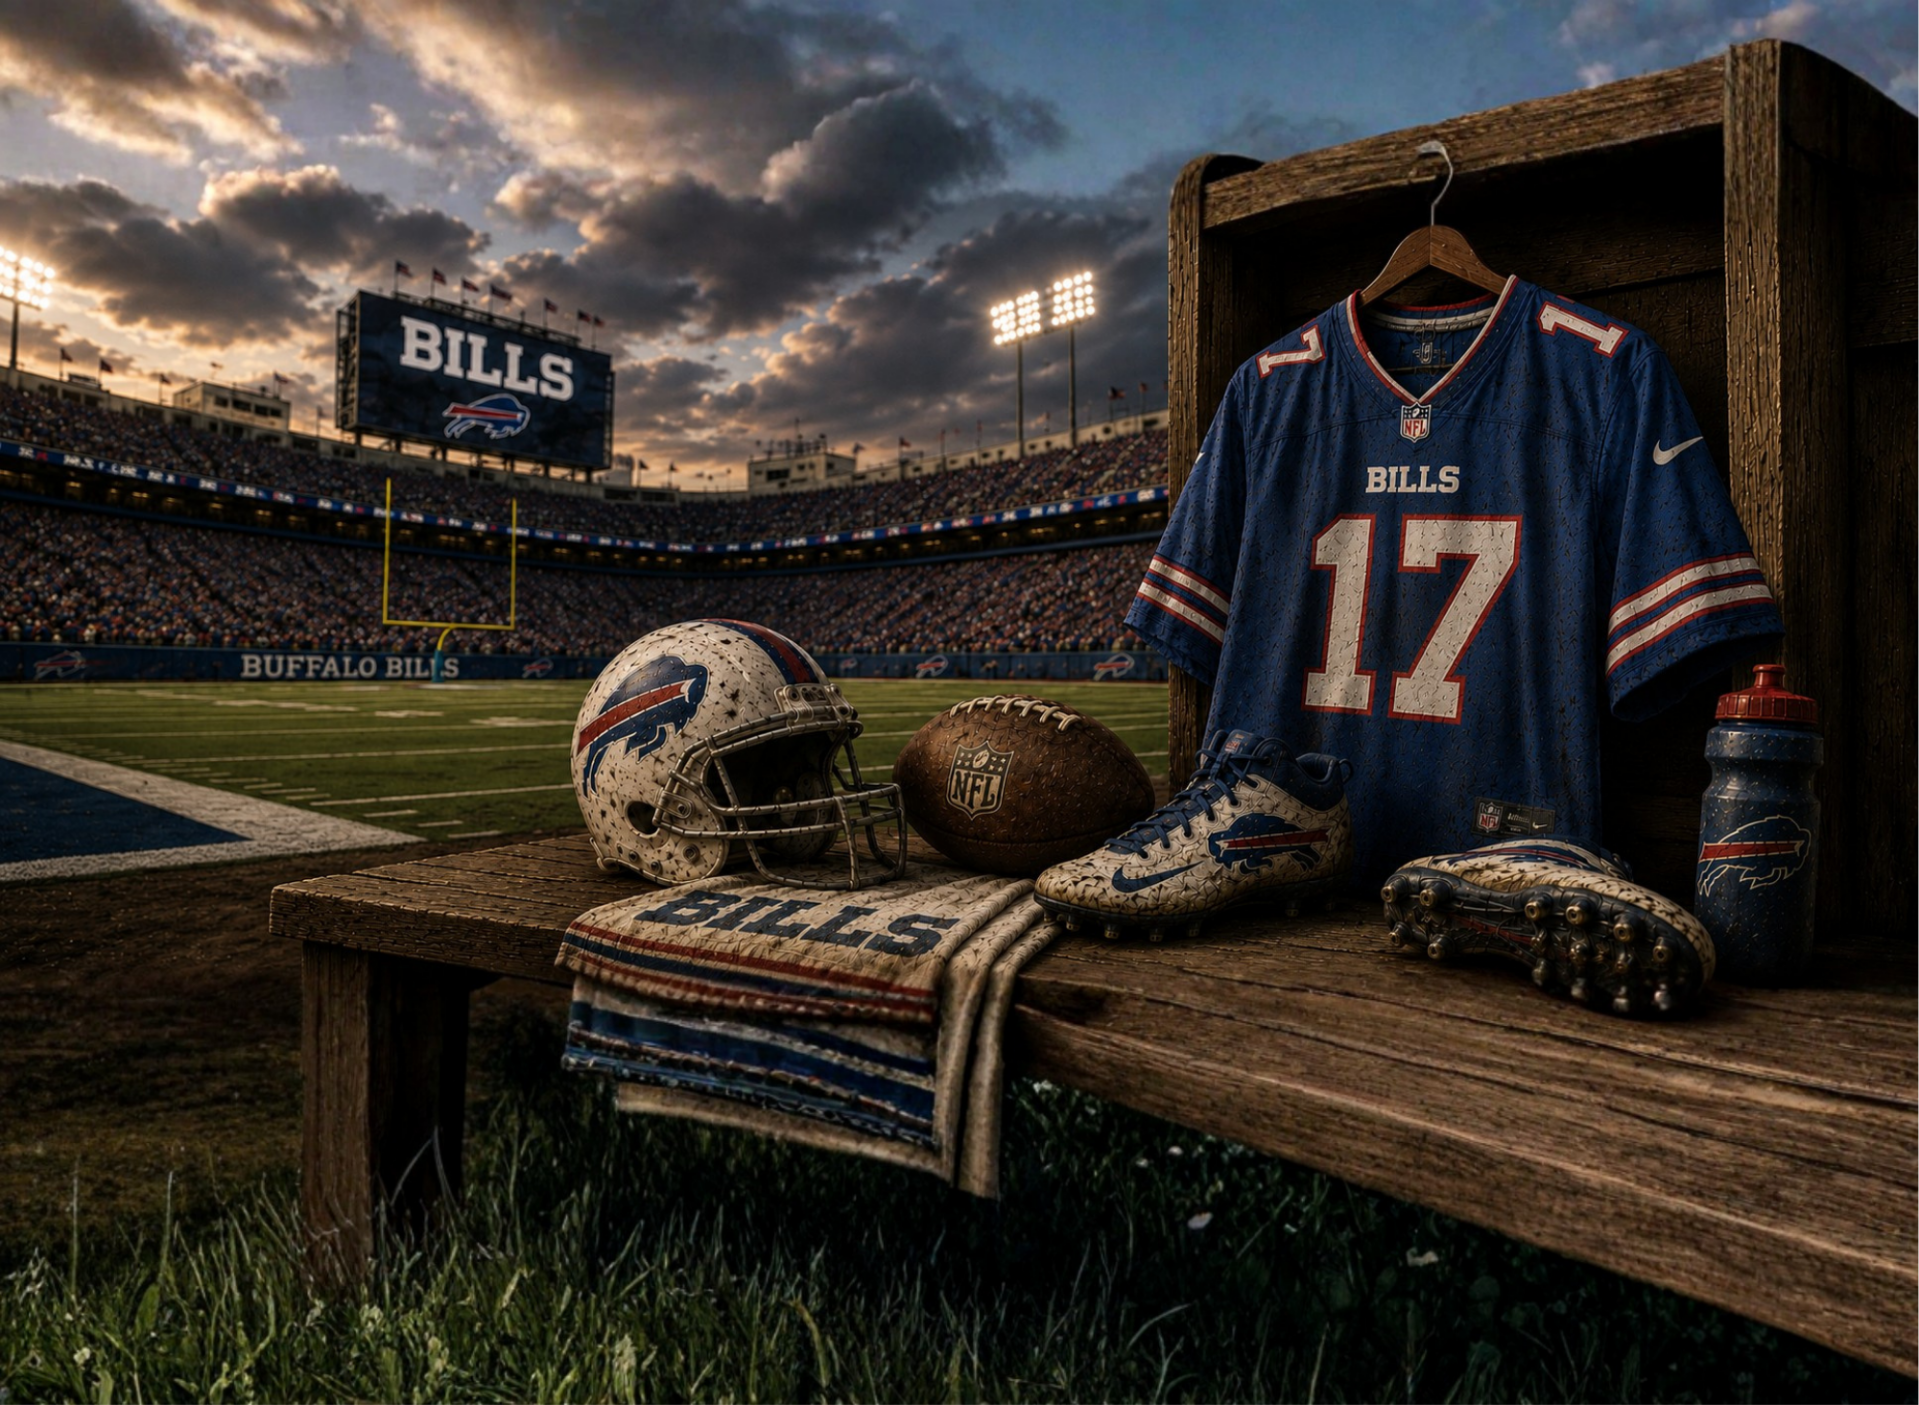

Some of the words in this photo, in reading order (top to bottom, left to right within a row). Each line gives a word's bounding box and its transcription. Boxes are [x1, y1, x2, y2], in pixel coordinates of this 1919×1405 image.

[400, 315, 574, 401] BILLS
[1404, 419, 1427, 437] NFL
[1365, 465, 1460, 494] BILLS
[1301, 513, 1523, 725] 17
[240, 654, 377, 678] BUFFALO
[951, 770, 997, 810] NFL
[633, 890, 960, 957] BILLS
